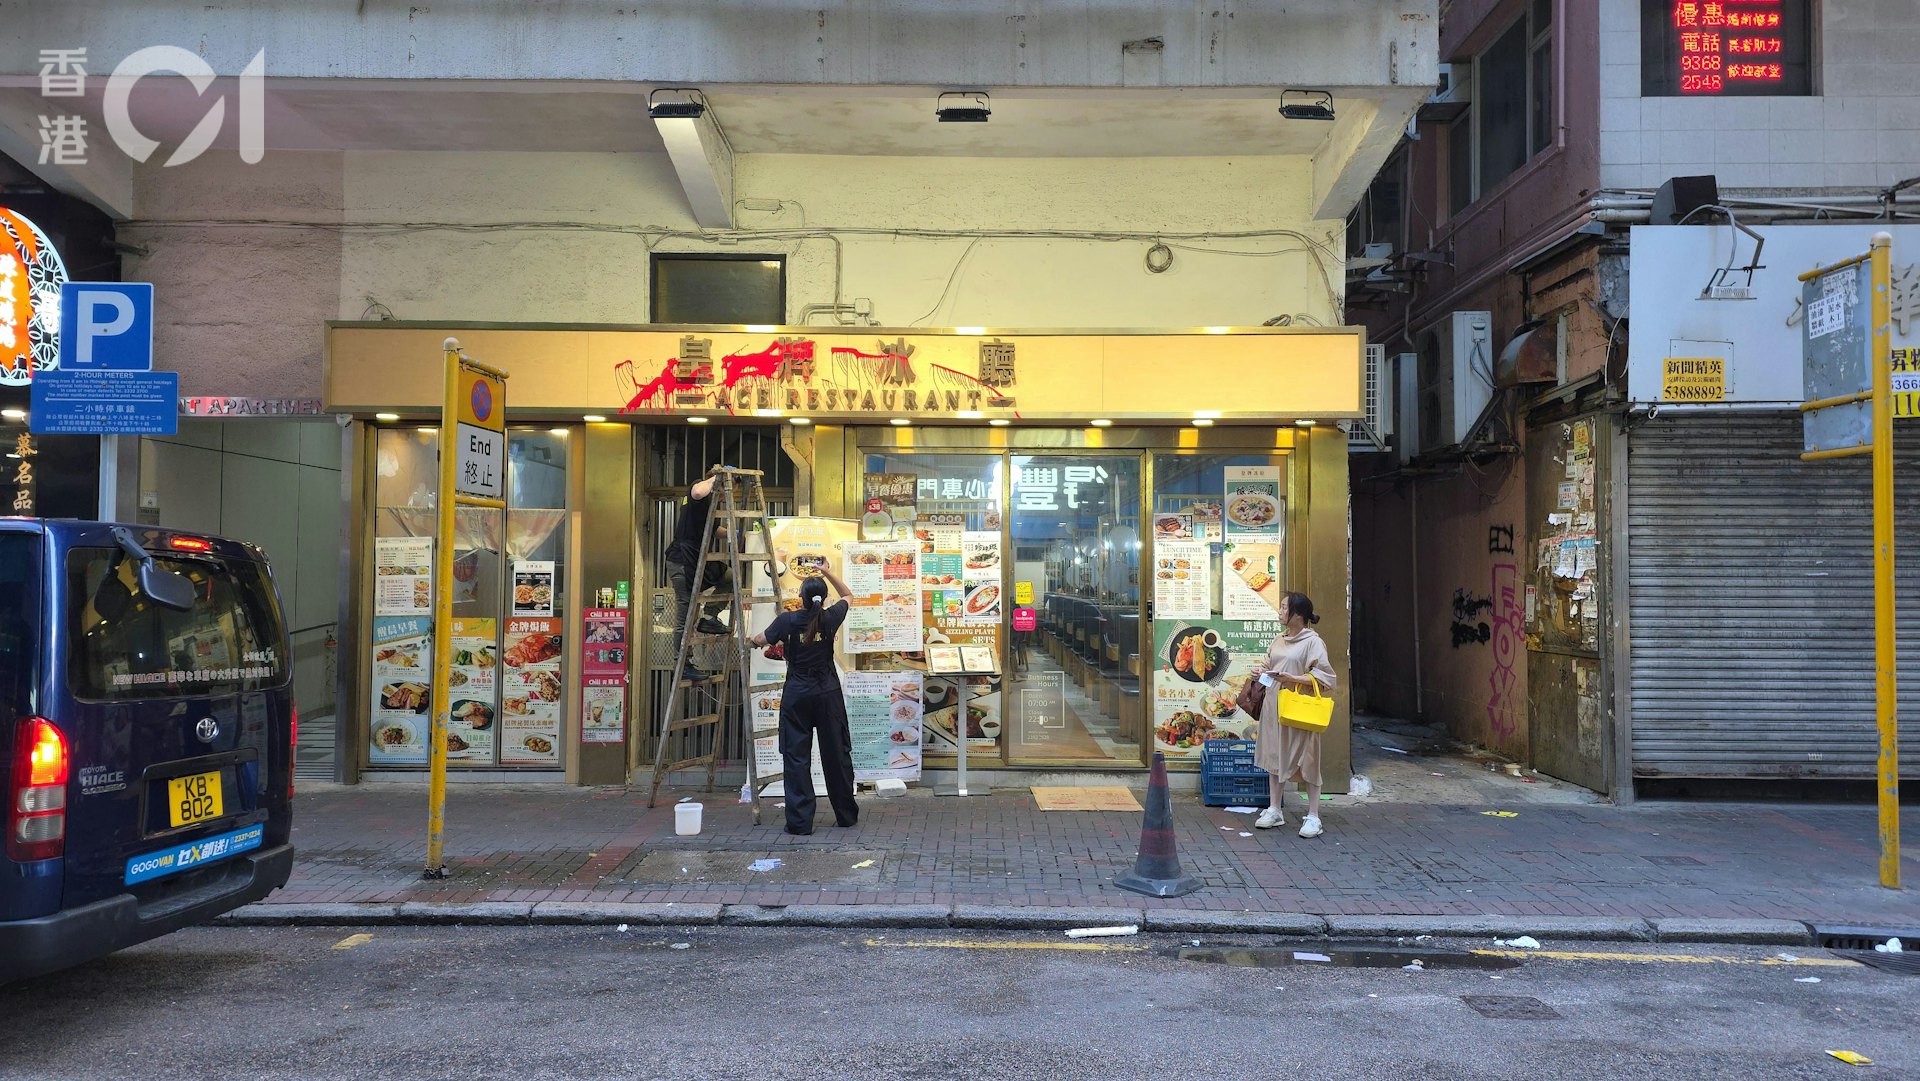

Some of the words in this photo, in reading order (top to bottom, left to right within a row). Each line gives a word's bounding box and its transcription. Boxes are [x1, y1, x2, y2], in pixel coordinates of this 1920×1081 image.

[1675, 2, 1724, 26] 優惠
[1681, 32, 1720, 52] 電話
[1681, 55, 1721, 71] 9368
[1681, 75, 1721, 90] 2548
[76, 290, 135, 362] P
[1667, 360, 1722, 375] 新聞精英
[714, 388, 770, 411] ACE
[785, 388, 982, 411] RESTAURANT
[1664, 385, 1722, 399] 53888892
[470, 434, 491, 456] End
[464, 460, 493, 488] 終止
[972, 636, 996, 644] SETS
[113, 674, 134, 685] NEW
[133, 672, 166, 684] HIACE
[81, 766, 107, 775] TOYOTA
[81, 771, 124, 787] HIACE
[185, 776, 207, 799] KB
[181, 796, 214, 821] 802
[131, 853, 175, 875] GOGOVAN
